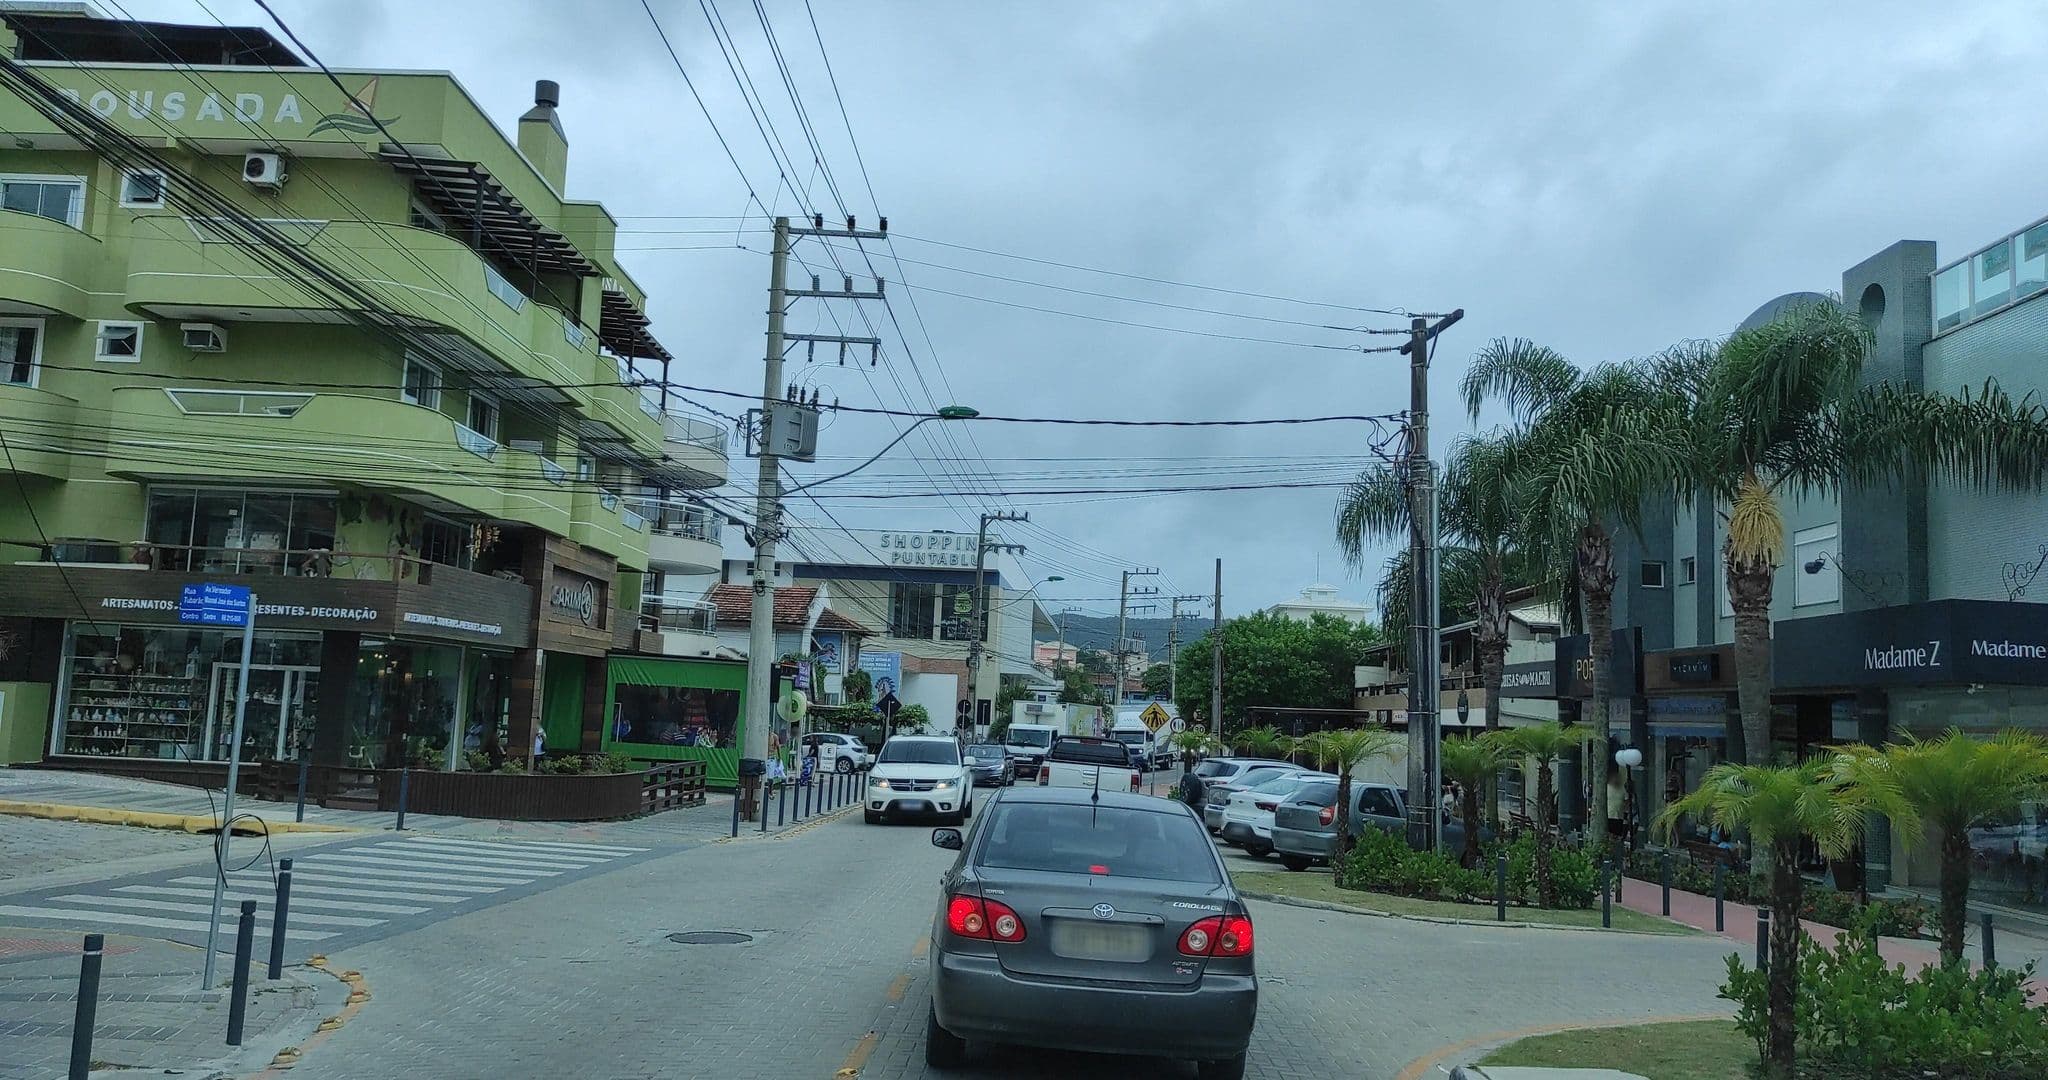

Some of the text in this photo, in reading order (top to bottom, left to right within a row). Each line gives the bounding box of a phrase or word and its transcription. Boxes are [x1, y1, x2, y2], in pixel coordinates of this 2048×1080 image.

[184, 587, 197, 595] Rua
[1864, 640, 1940, 670] Madame Z
[1971, 639, 2046, 659] Madame
[1173, 901, 1210, 910] COROLLA
